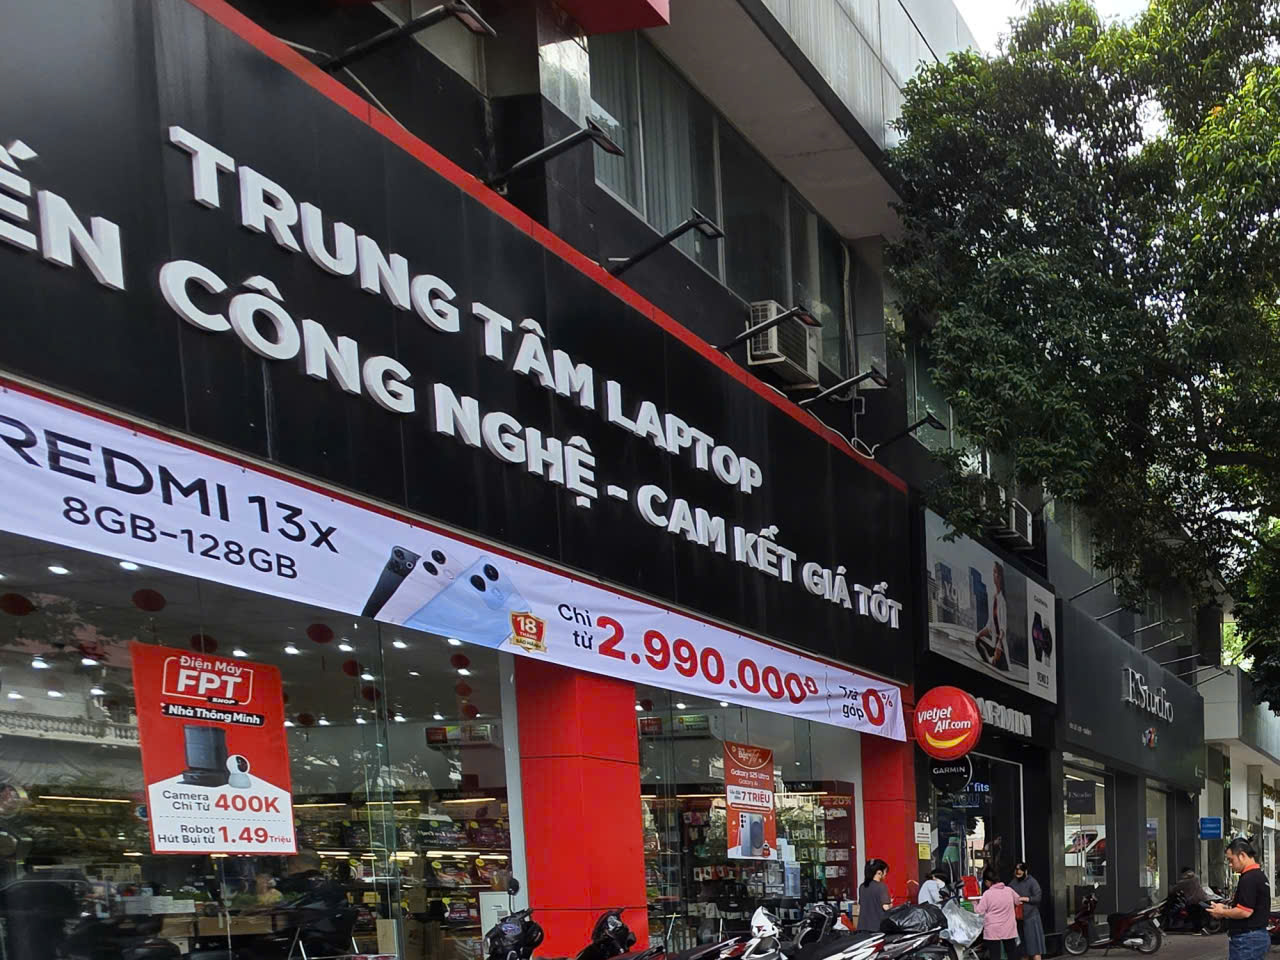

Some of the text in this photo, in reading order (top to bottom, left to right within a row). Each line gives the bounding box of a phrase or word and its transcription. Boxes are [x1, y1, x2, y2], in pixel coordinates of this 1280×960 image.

[169, 125, 763, 494] TRUNG TÂM LAPTOP
[159, 259, 416, 414] CÔNG
[433, 383, 598, 508] NGHỆ
[637, 484, 727, 555] CAM
[734, 524, 797, 583] KẾT
[802, 565, 853, 610] GIÁ
[854, 582, 903, 629] TỐT
[0, 414, 230, 522] REDMI
[62, 496, 298, 580] 8GB-128GB
[516, 616, 537, 634] 18
[179, 655, 243, 676] Điện Máy
[176, 669, 243, 699] FPT
[168, 705, 261, 725] Nhà Thông Minh
[968, 693, 1033, 738] ARMIN
[932, 766, 966, 775] GARMIN
[162, 790, 209, 802] Camera
[214, 793, 281, 814] 400K
[157, 833, 179, 844] Hút
[180, 824, 216, 834] Robot
[217, 825, 269, 845] 1.49
